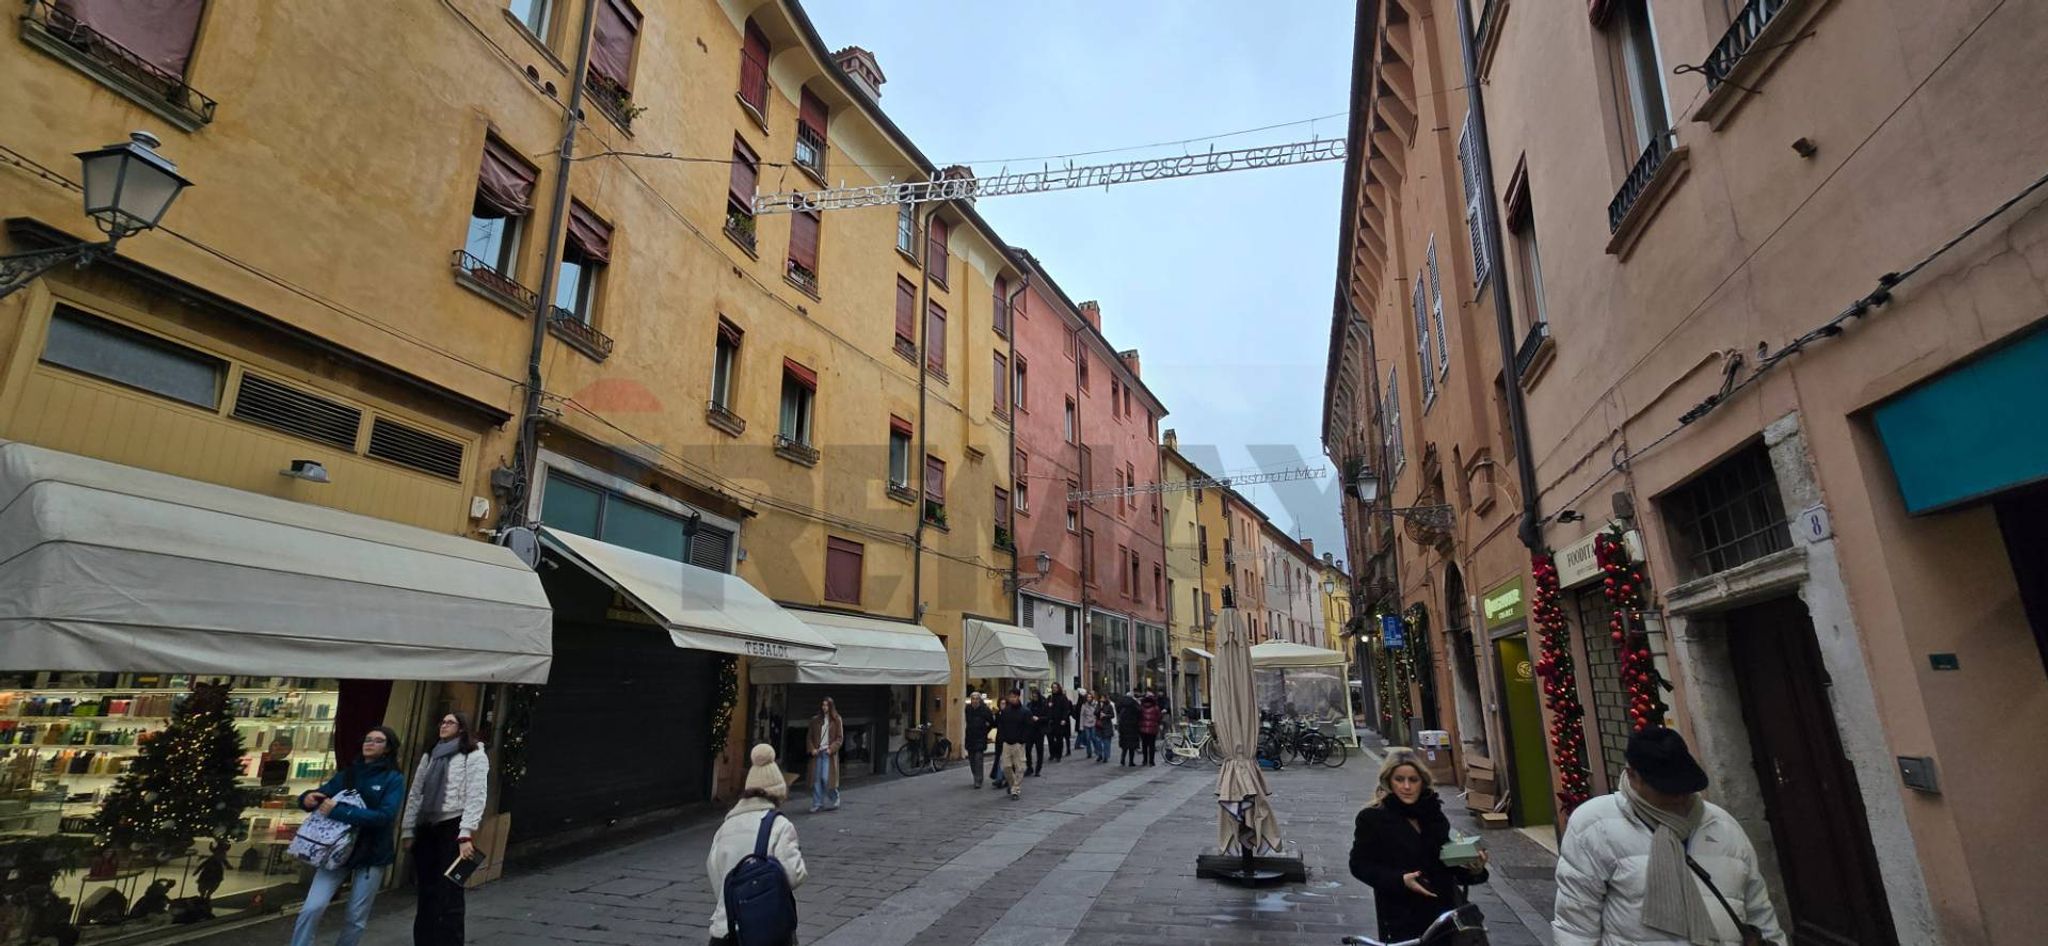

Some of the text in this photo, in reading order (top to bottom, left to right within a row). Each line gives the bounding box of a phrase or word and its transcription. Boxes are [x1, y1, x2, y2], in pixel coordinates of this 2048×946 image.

[1065, 157, 1194, 193] imprese
[1246, 133, 1347, 169] canto
[1811, 514, 1822, 536] 8
